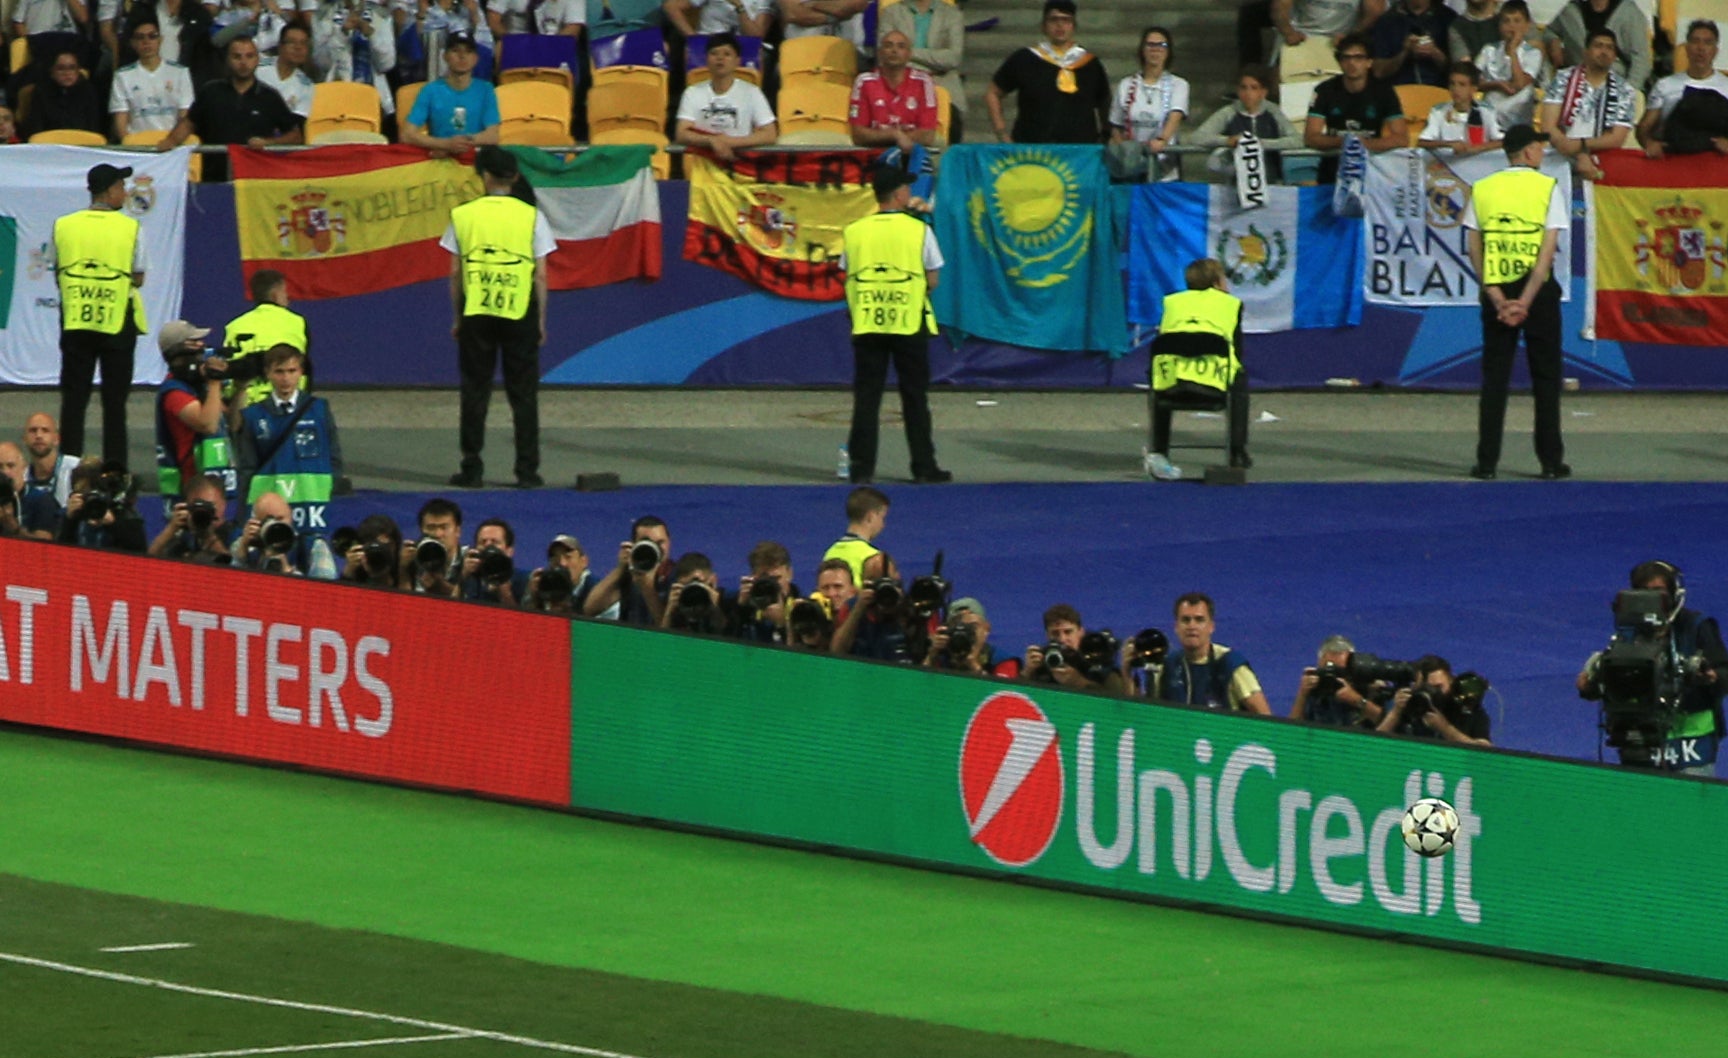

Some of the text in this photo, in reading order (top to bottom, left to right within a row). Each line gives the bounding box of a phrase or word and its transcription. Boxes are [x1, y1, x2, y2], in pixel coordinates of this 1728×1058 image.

[1487, 239, 1539, 257] EWARD
[70, 593, 395, 738] MATTERS
[1075, 721, 1482, 925] UniCredit
